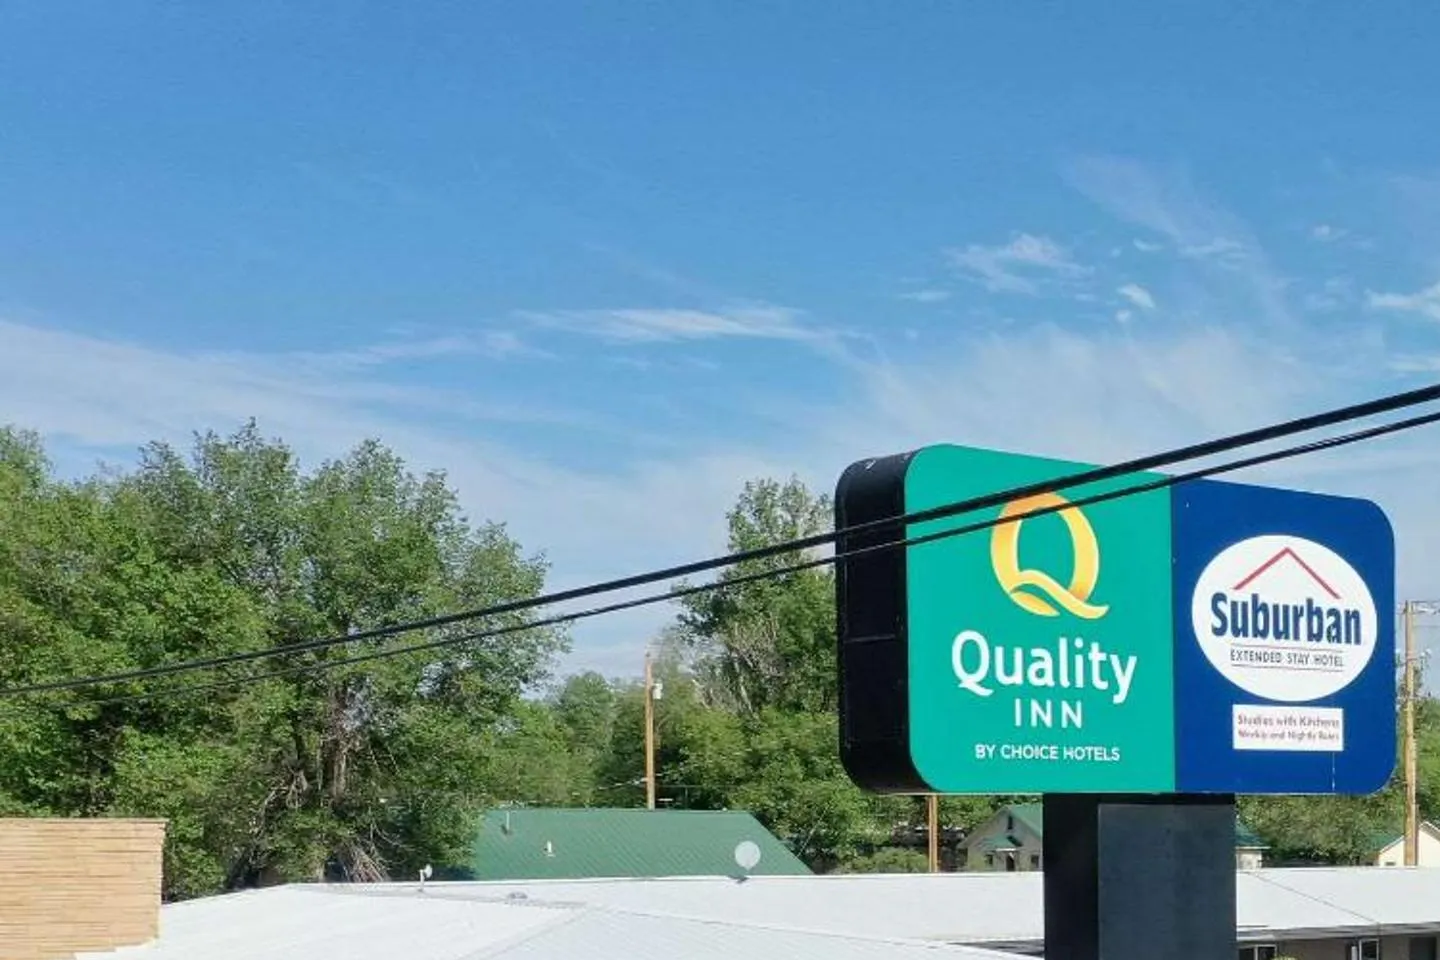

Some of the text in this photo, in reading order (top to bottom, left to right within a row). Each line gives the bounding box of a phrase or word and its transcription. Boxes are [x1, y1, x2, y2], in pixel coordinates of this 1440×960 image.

[990, 488, 1110, 619] Q
[1211, 592, 1362, 645] Suburban
[951, 629, 1137, 705] Quality
[1230, 649, 1344, 667] EXTENDED STAY HOTEL
[1014, 698, 1082, 729] INN
[975, 744, 1121, 762] BY CHOICE HOTELS
